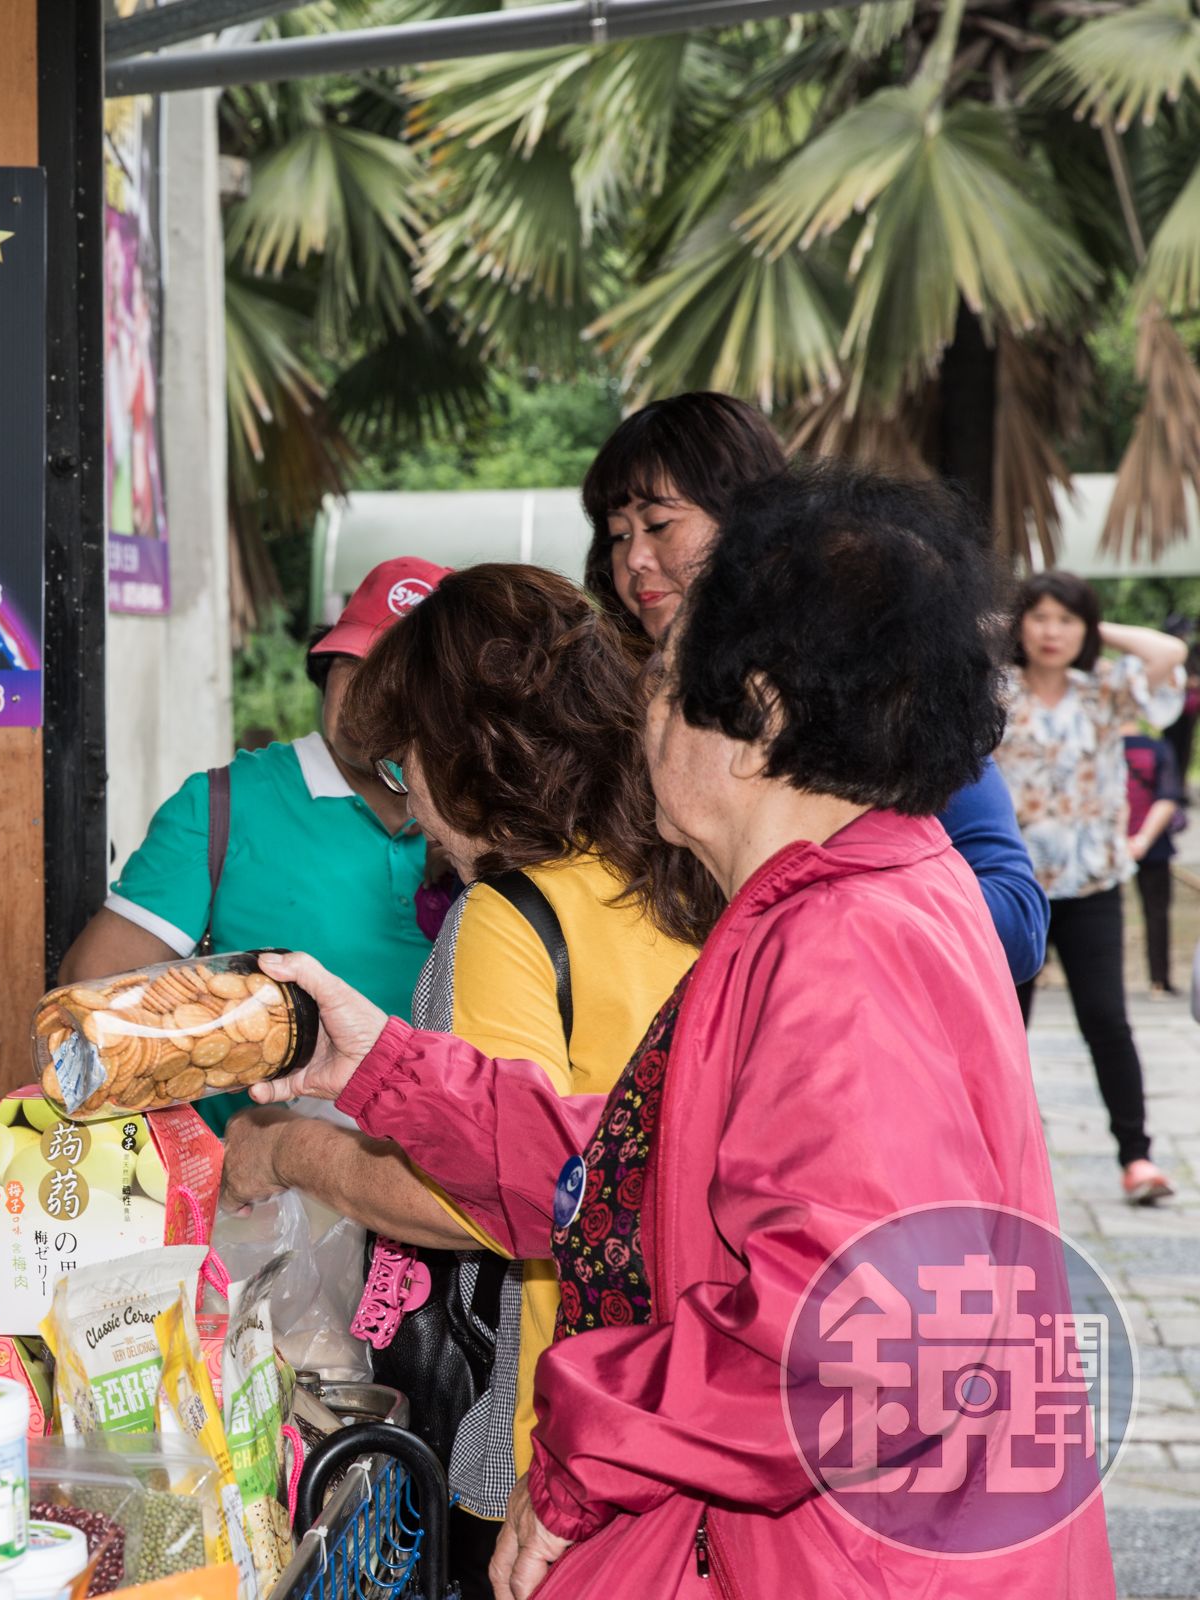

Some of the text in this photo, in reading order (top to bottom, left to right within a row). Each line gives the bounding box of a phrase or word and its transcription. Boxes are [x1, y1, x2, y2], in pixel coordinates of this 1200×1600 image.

[45, 1120, 84, 1219] 蒟蒻
[33, 1229, 49, 1297] 梅ゼリー
[85, 1313, 121, 1350] Classic
